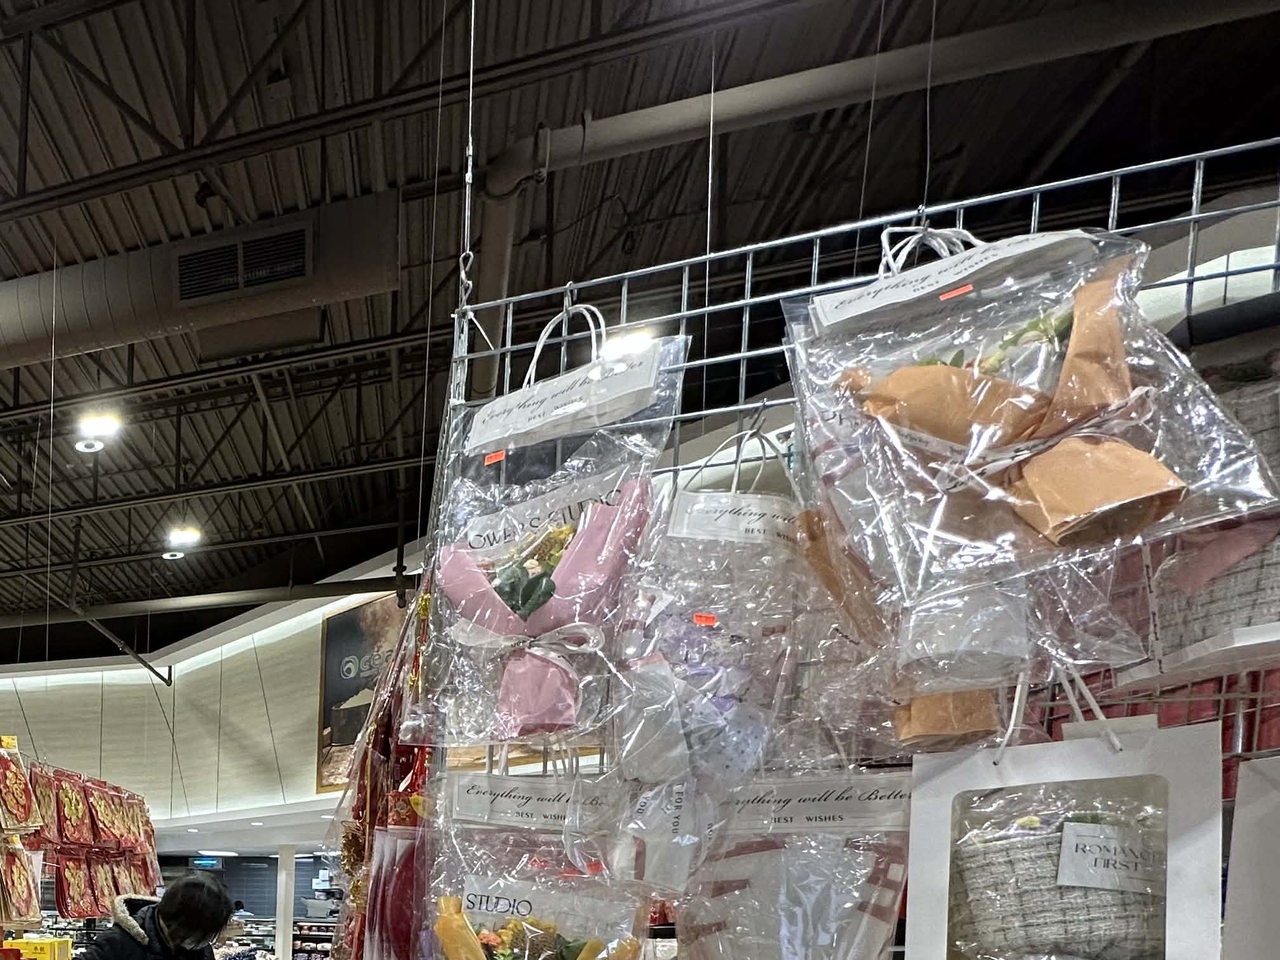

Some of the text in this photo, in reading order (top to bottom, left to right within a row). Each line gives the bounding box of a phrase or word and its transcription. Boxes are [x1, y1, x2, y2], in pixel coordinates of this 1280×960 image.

[482, 395, 548, 425] Everything
[744, 527, 767, 535] BEST
[466, 784, 566, 808] Everything will
[797, 789, 831, 805] will
[835, 788, 853, 803] be
[672, 791, 685, 836] FOR YOU
[805, 814, 844, 824] WISHES
[1093, 857, 1139, 872] FIRST
[466, 893, 533, 917] STUDIO
